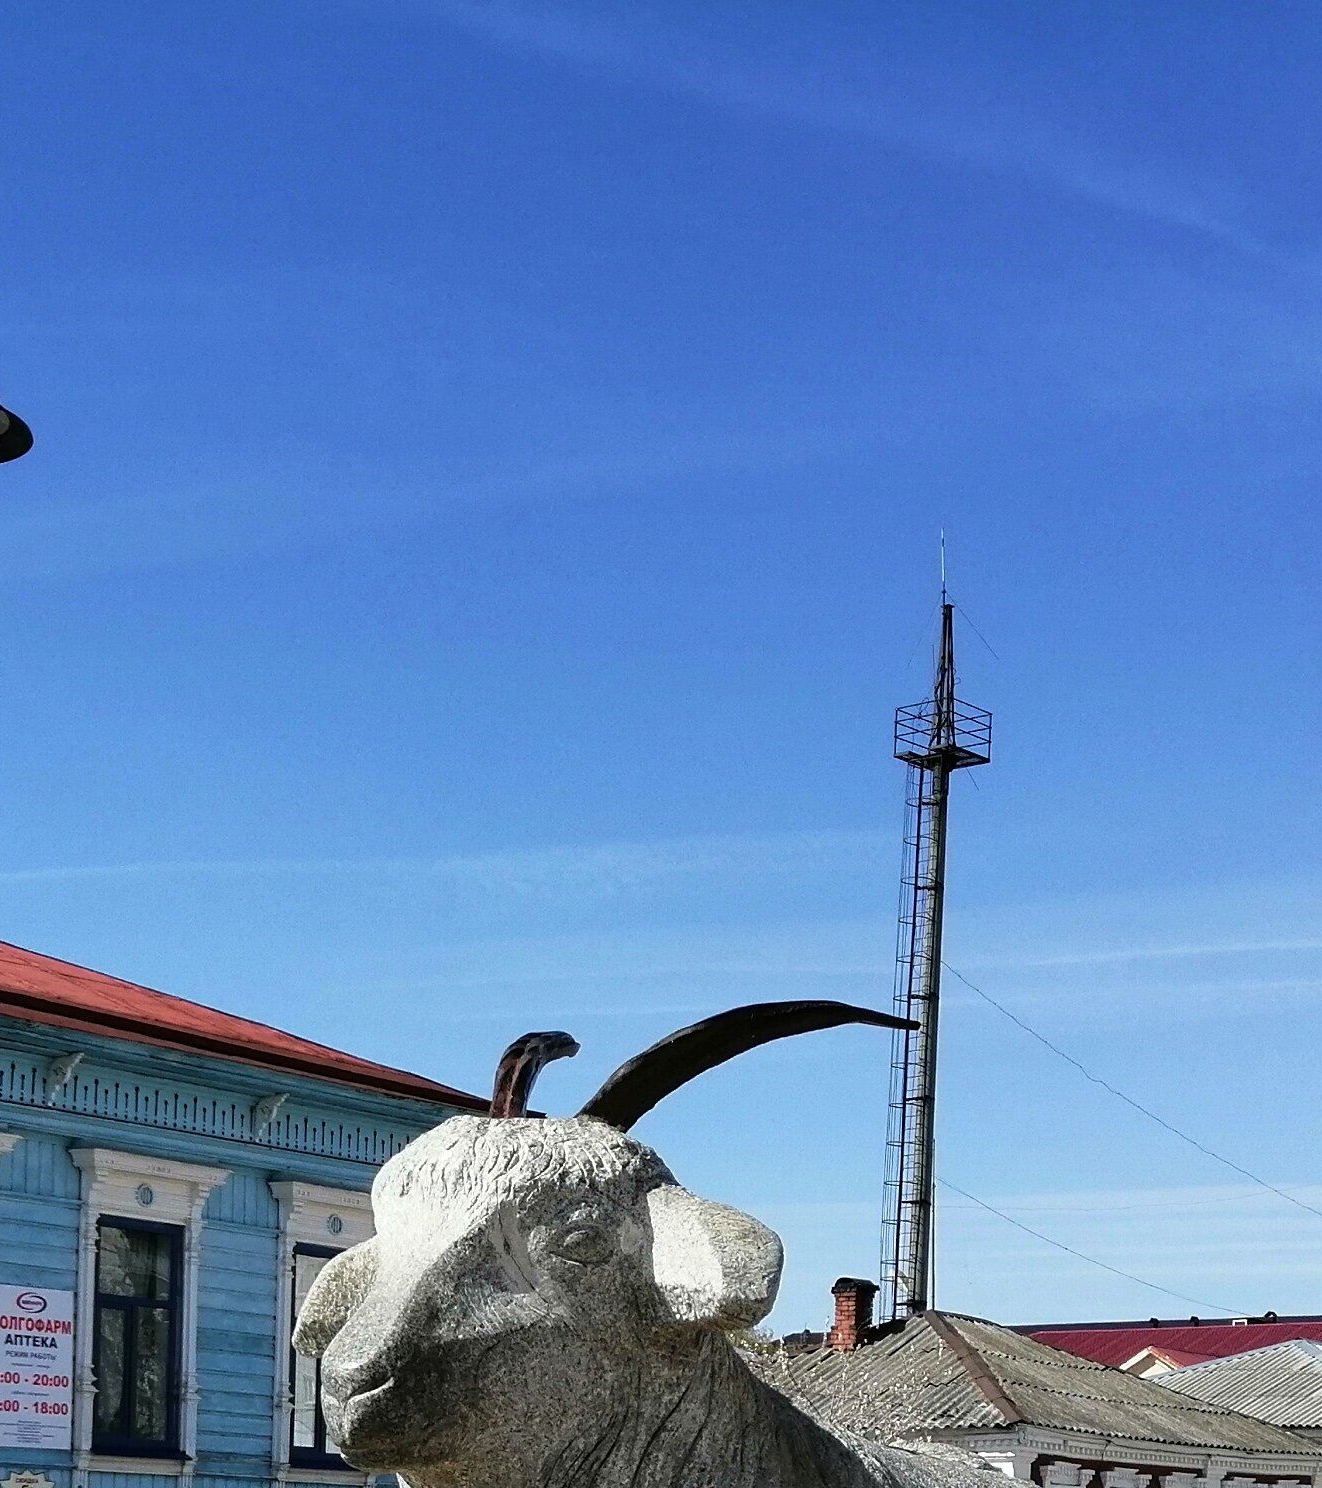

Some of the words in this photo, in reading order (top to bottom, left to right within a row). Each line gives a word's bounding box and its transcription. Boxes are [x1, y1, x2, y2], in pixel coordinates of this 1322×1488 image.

[5, 1333, 58, 1348] АПТЕКА
[5, 1350, 29, 1358] РЕЖИМ
[30, 1352, 57, 1361] РАБОТЫ
[33, 1374, 69, 1388] 20:00
[33, 1401, 69, 1415] 18:00
